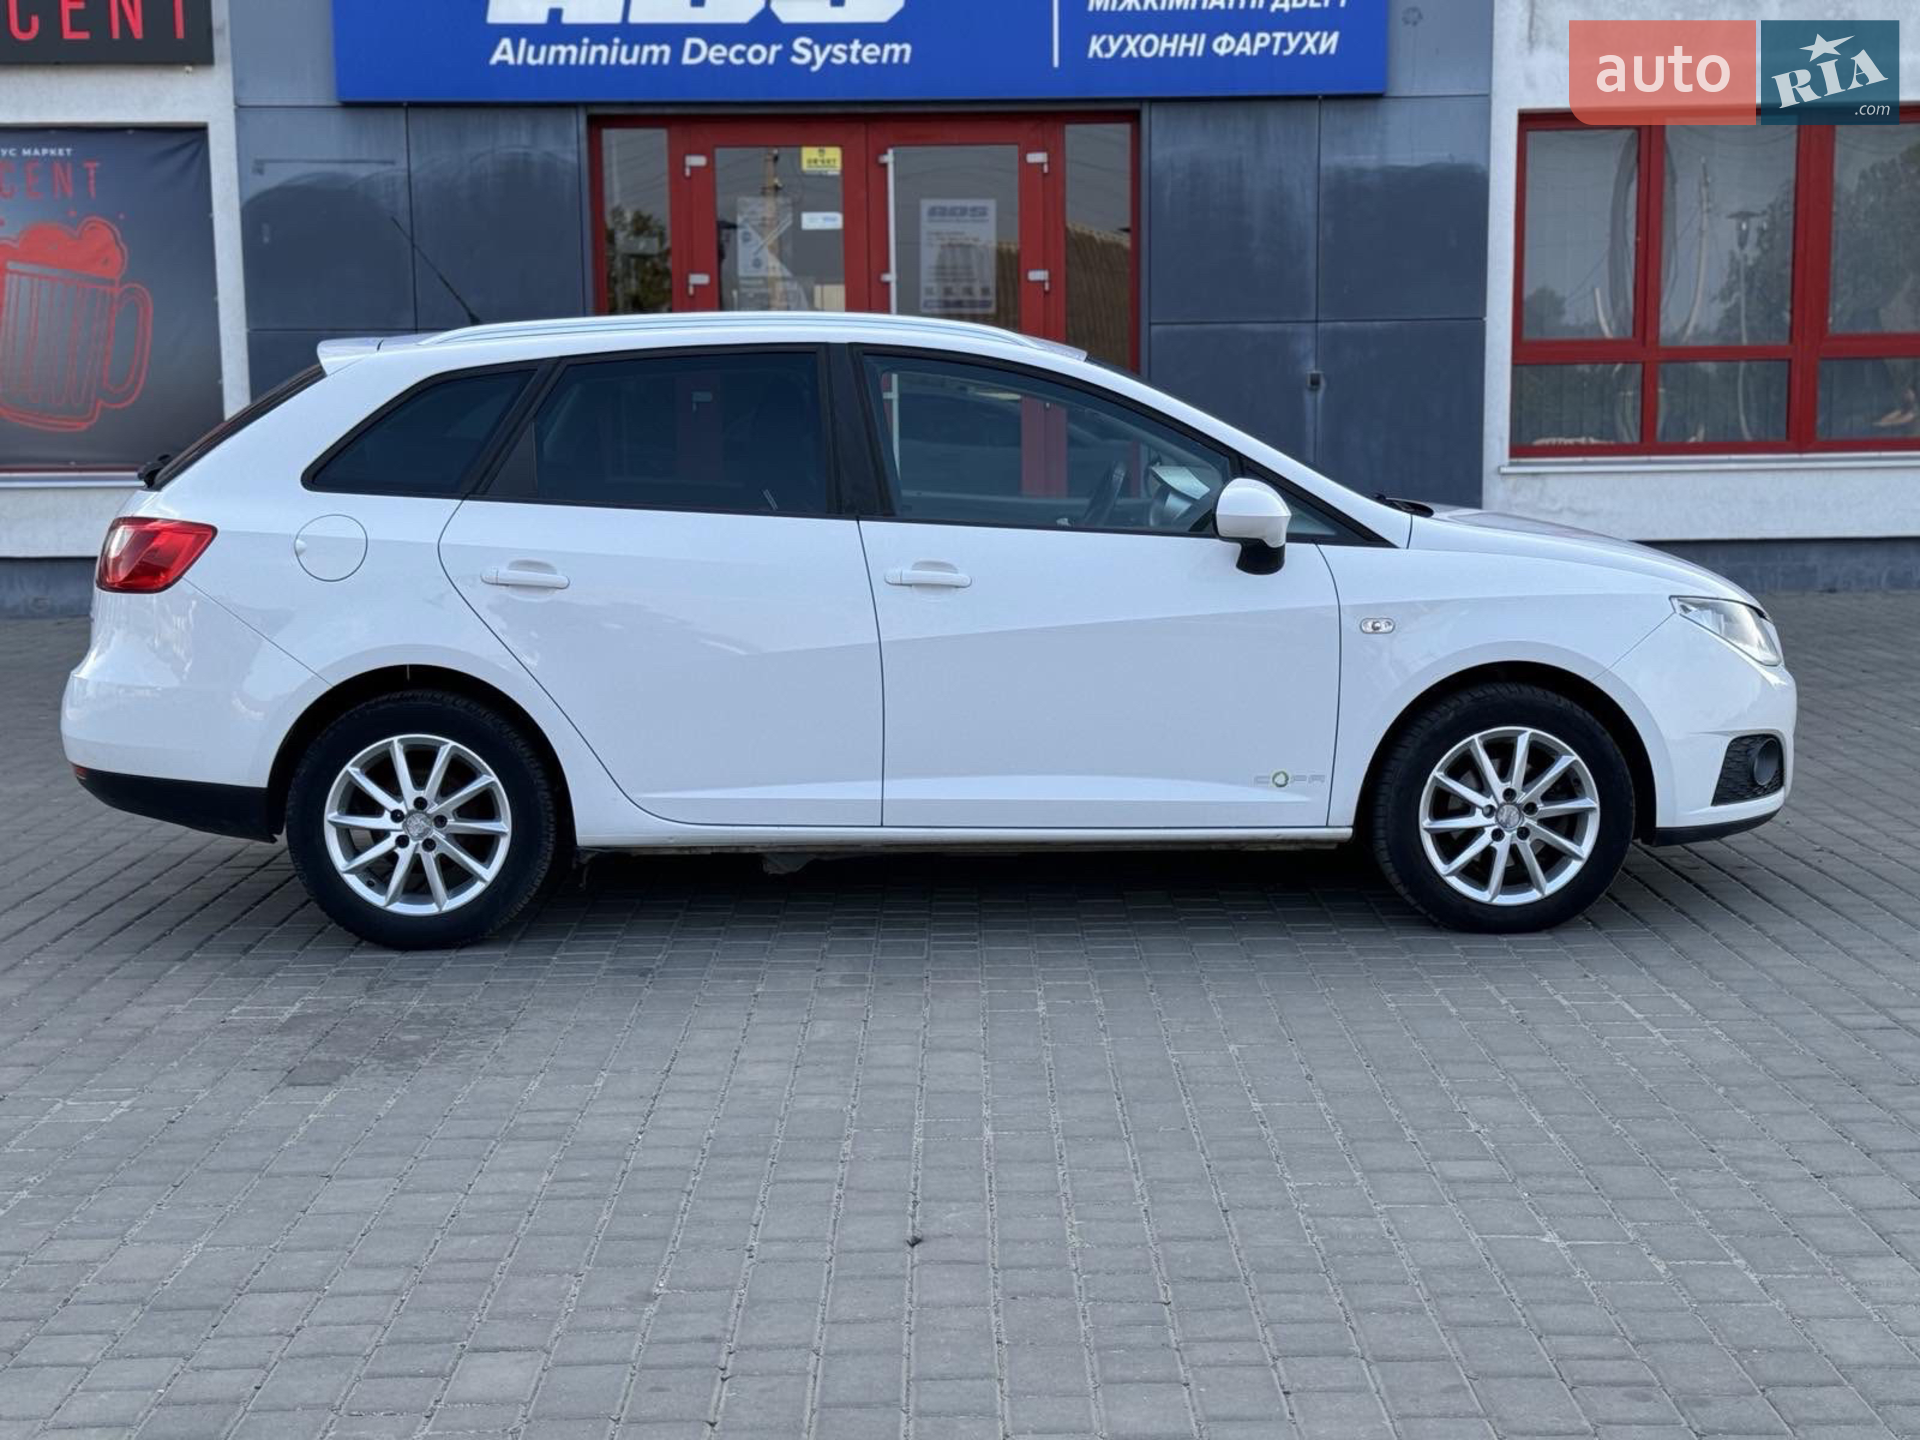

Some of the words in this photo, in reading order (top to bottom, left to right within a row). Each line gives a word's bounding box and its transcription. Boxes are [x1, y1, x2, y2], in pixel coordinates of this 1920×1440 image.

[489, 37, 673, 66] Aluminium
[681, 37, 783, 66] Decor
[789, 37, 912, 72] System
[1087, 33, 1207, 59] КУХОННІ
[1211, 30, 1341, 58] ФАРТУХИ
[22, 147, 73, 158] МАРКЕТ
